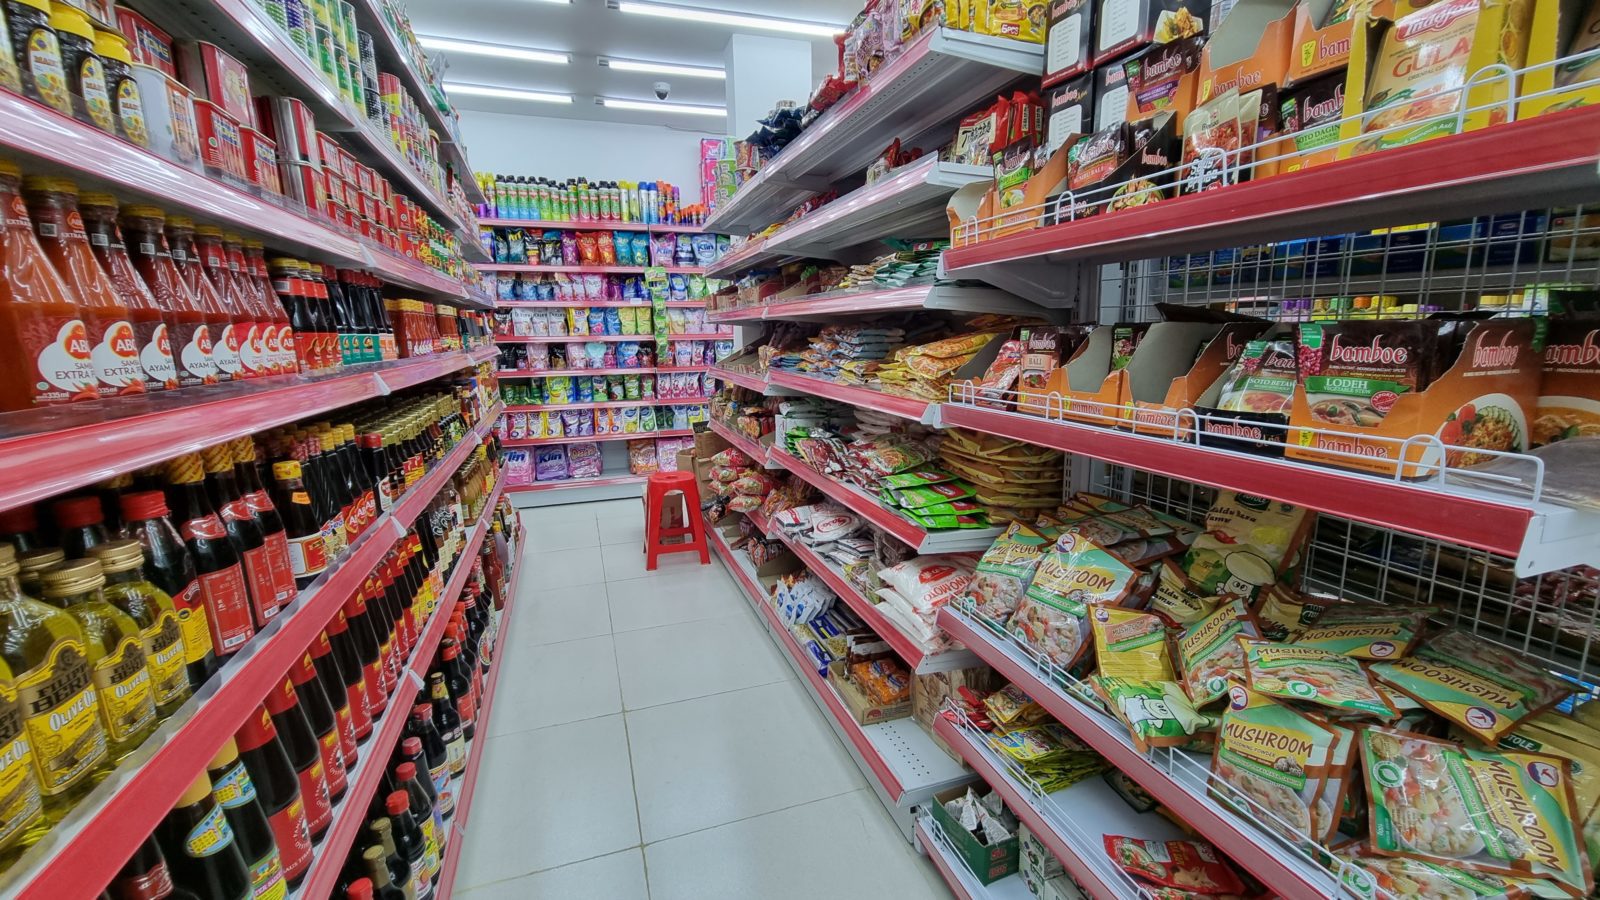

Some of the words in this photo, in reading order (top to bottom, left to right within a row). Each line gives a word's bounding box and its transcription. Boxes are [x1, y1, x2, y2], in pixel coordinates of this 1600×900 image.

[1143, 50, 1183, 80] bamboe
[1213, 66, 1261, 97] bamboe
[1329, 333, 1408, 364] bamboe
[1472, 330, 1519, 368] bamboe
[1544, 329, 1600, 365] amb
[56, 370, 89, 380] EXTRA
[103, 367, 135, 377] EXTRA
[189, 362, 210, 370] AYAM
[1325, 378, 1368, 390] LODEH
[1204, 413, 1262, 440] bamboe
[539, 451, 562, 464] Klin
[1316, 429, 1389, 459] bamboe
[1041, 561, 1116, 592] MUSHROOM
[1111, 620, 1147, 637] MUSHROOM
[1182, 606, 1236, 652] MUSHROOM
[1298, 625, 1401, 642] MUSHROOM
[1398, 657, 1518, 711] MUSHROOM
[49, 700, 84, 732] OLIVE
[1223, 722, 1314, 758] MUSHROOM
